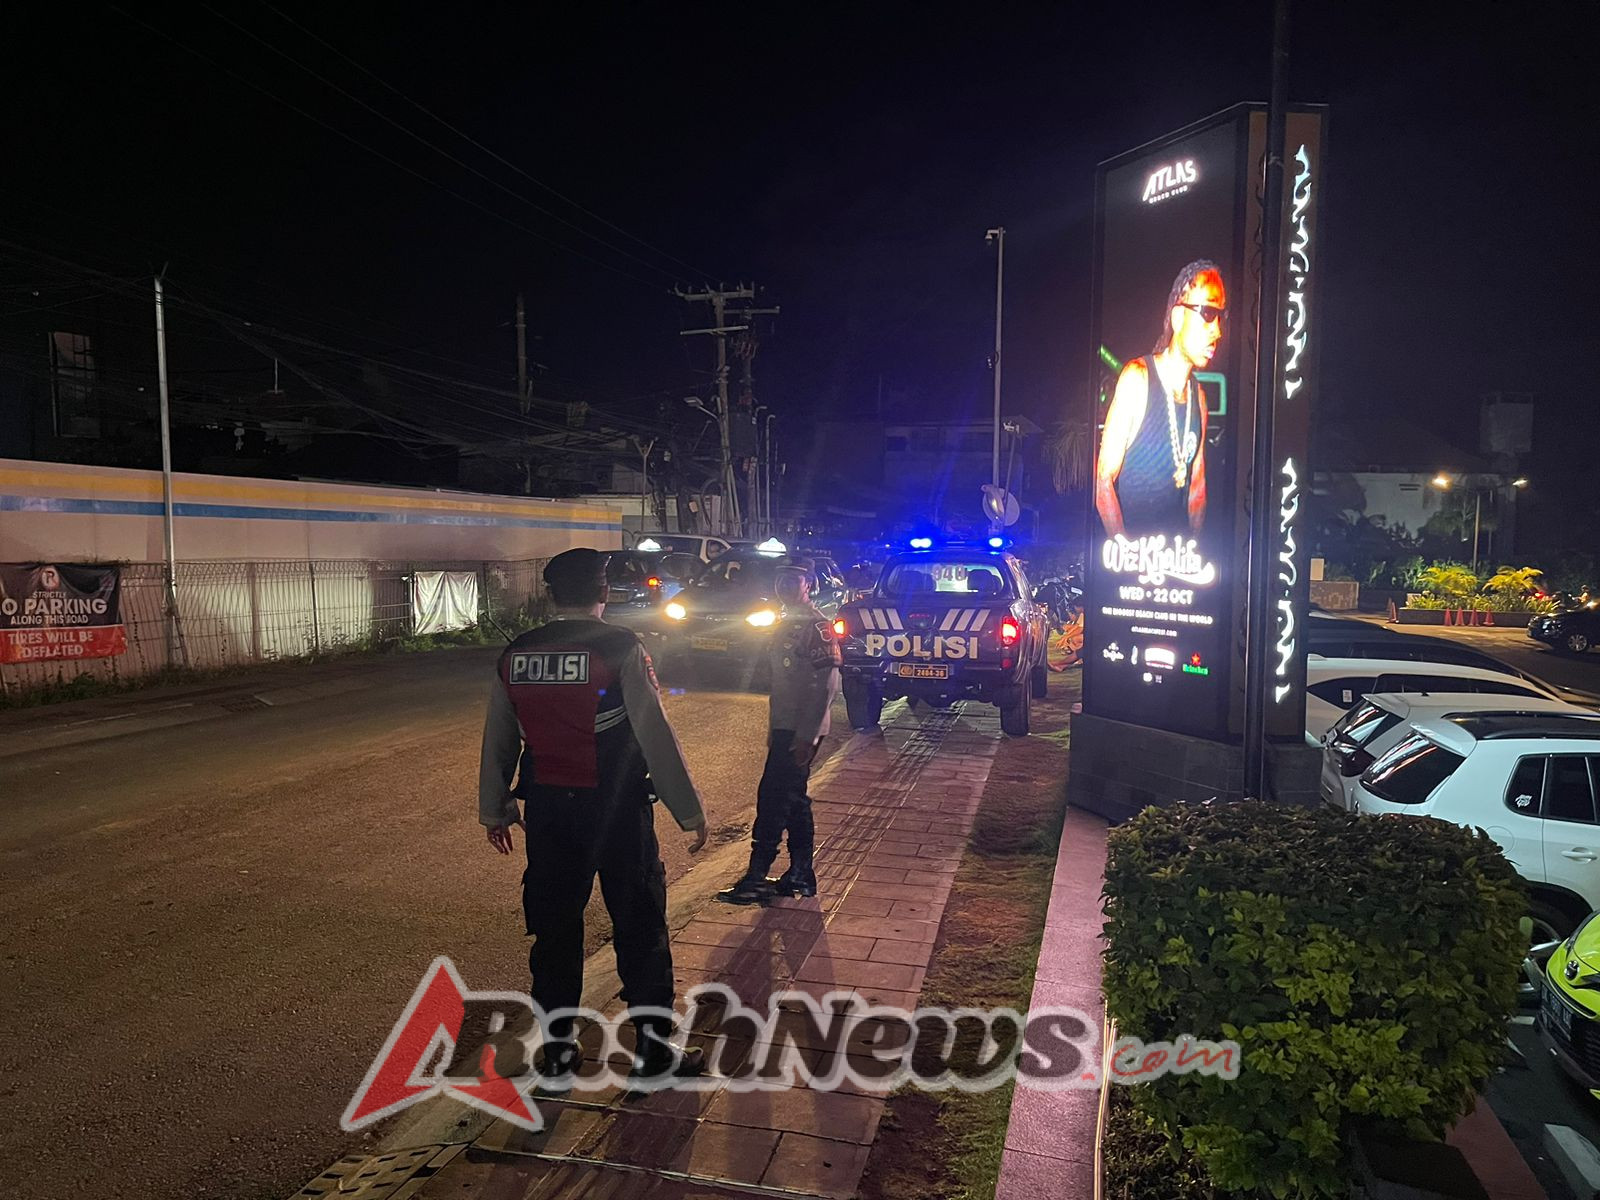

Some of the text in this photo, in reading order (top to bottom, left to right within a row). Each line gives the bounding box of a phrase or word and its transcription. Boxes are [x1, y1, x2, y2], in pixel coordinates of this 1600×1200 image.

[1142, 160, 1197, 202] ATLAS
[32, 591, 67, 599] STRICTLY
[1119, 586, 1194, 605] WED 22 OCT
[25, 598, 107, 615] PARKING
[11, 615, 88, 624] ALONG THIS ROAD
[8, 631, 94, 645] TIRES WILL BE
[865, 634, 978, 659] POLISI
[23, 645, 83, 658] DEFLATED
[513, 655, 585, 680] POLISI
